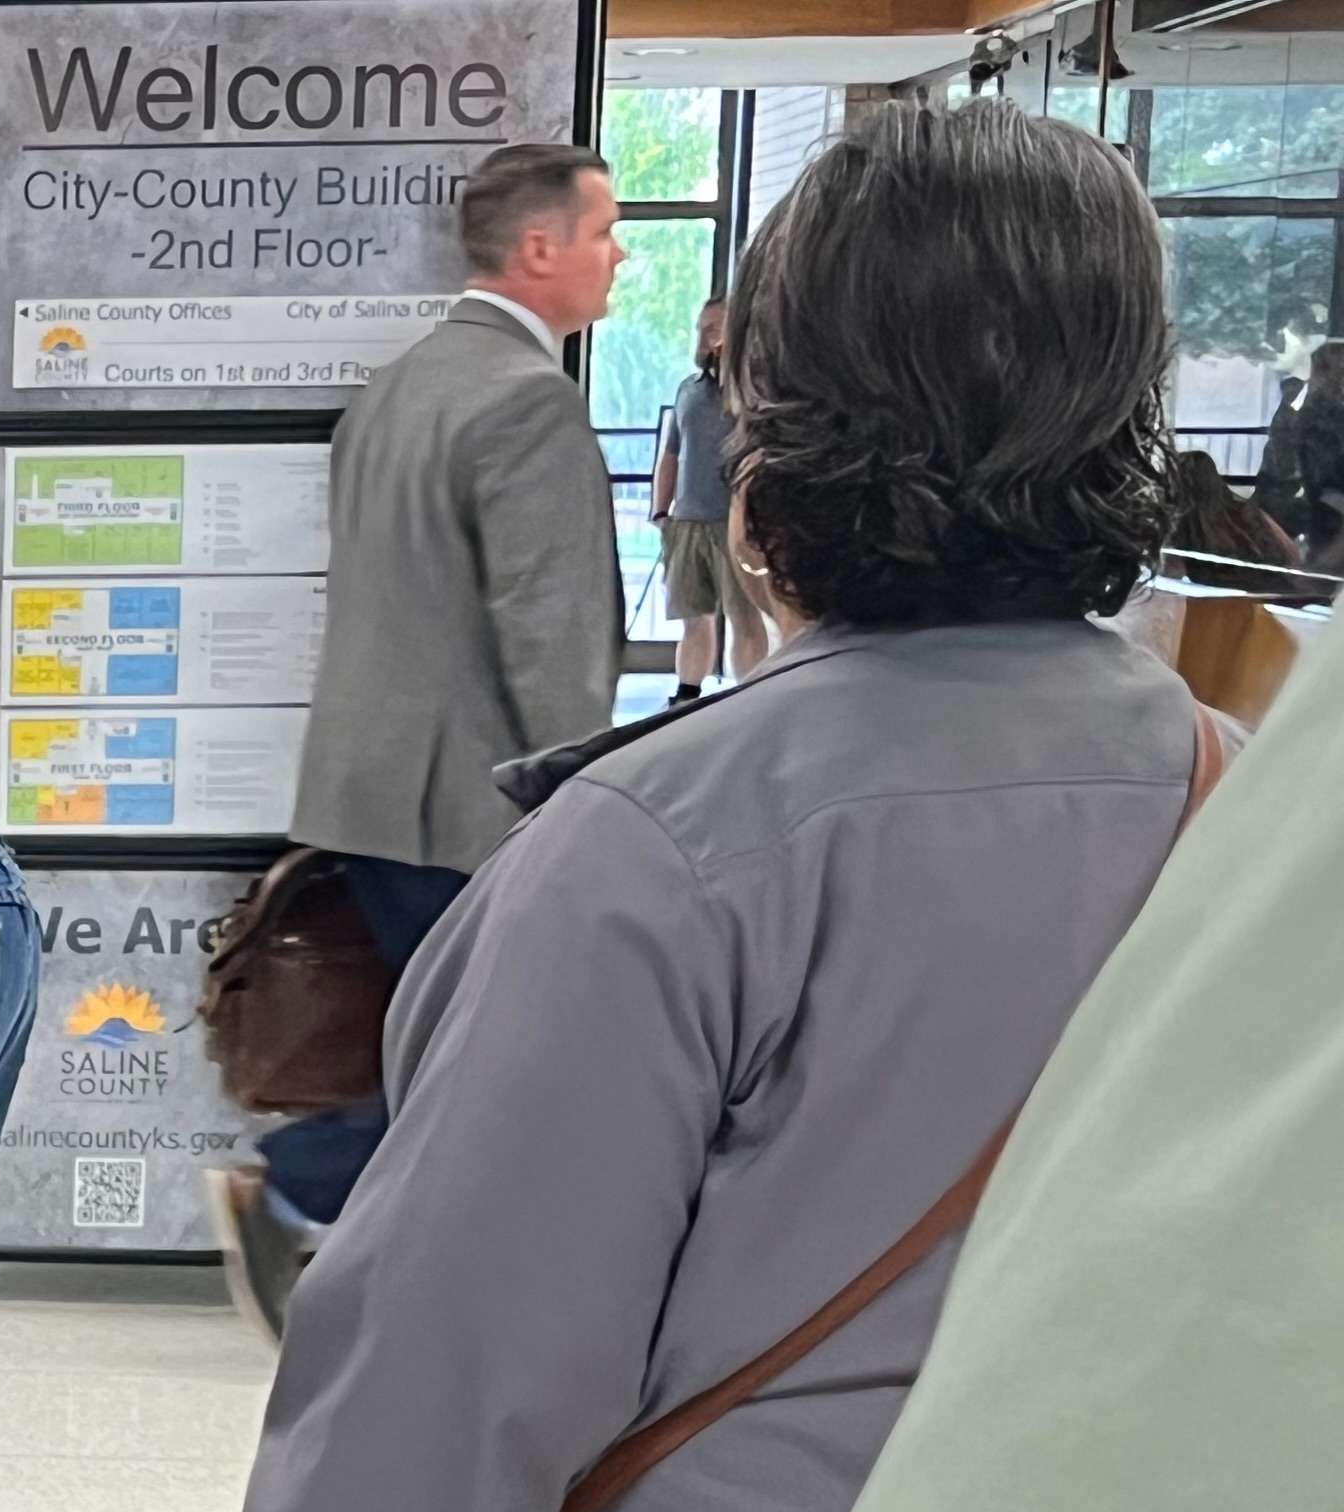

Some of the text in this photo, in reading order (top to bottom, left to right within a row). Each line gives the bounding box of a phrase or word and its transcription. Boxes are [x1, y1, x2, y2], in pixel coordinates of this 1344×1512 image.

[26, 45, 507, 133] Welcome
[23, 164, 467, 220] City-County Buildin
[130, 227, 388, 270] -2nd Floor-
[34, 303, 233, 324] Saline County Offices
[285, 300, 321, 322] City
[328, 300, 347, 318] of
[354, 299, 411, 318] Salina
[104, 364, 175, 383] Courts
[179, 366, 208, 382] on
[215, 362, 246, 382] 1st
[250, 362, 291, 381] and
[296, 361, 333, 381] 3rd
[60, 1050, 169, 1076] SALINE
[58, 1078, 168, 1096] COUNTY
[2, 1124, 240, 1156] alinecountyks.gov
